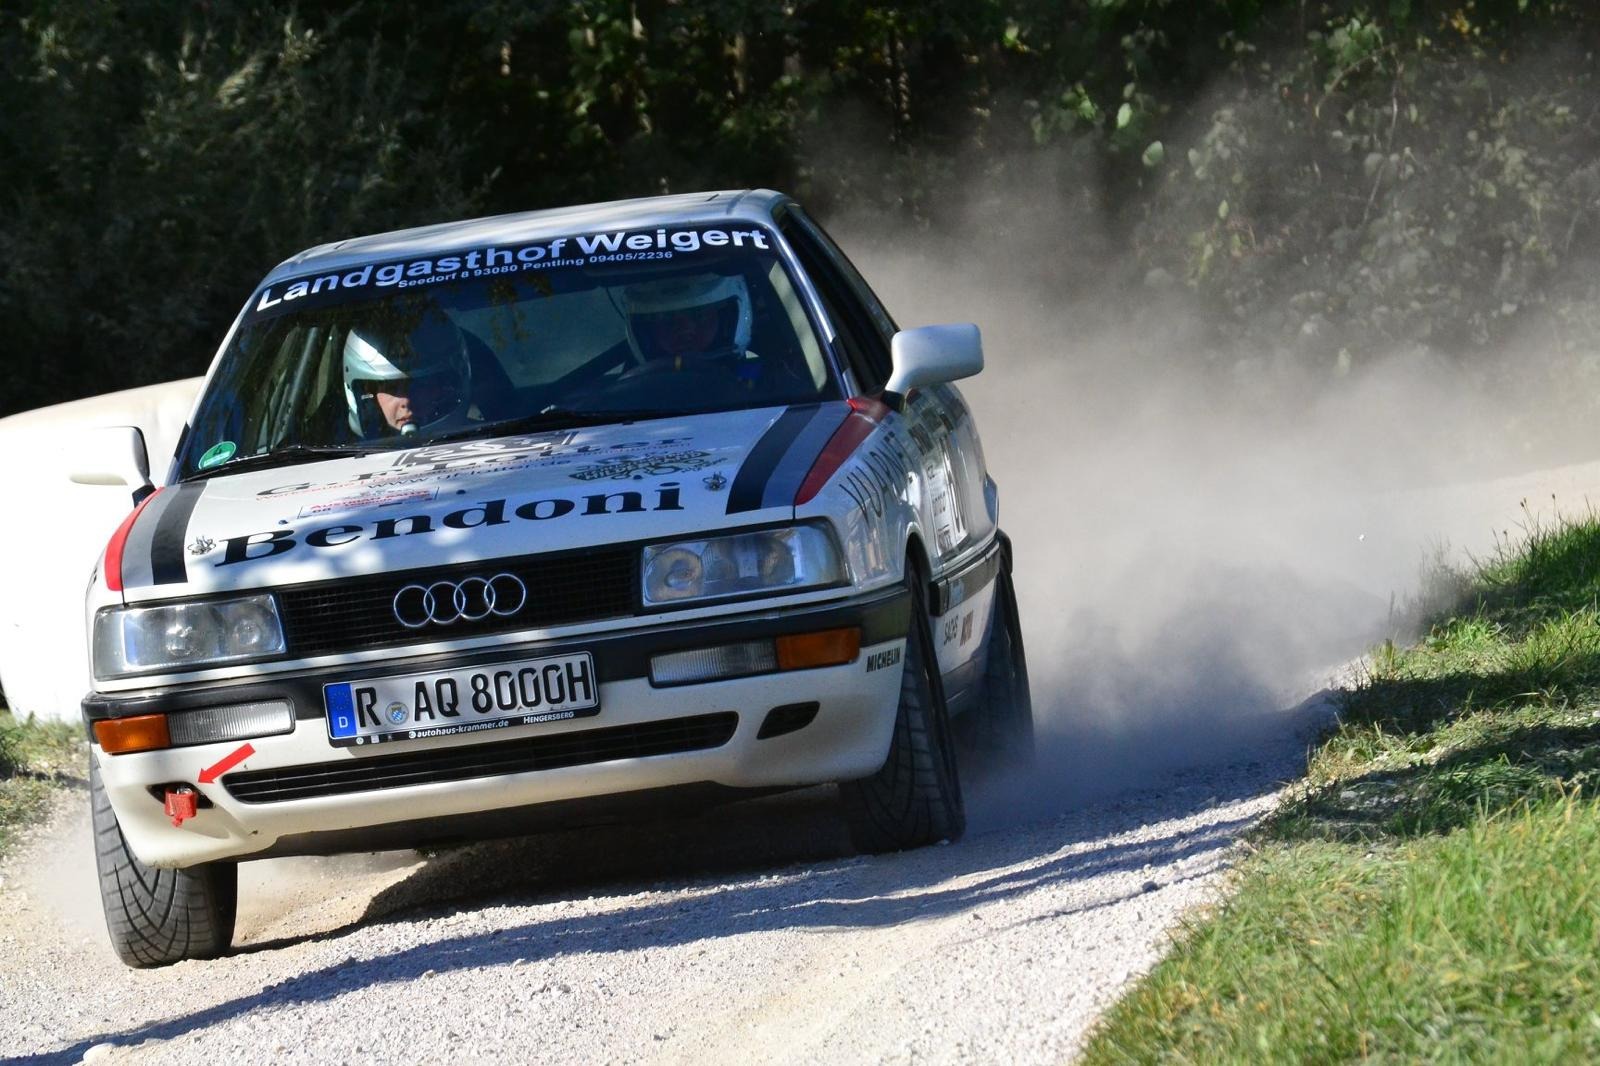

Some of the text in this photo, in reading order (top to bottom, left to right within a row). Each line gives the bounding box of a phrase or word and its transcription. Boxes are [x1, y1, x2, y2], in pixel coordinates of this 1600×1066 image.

[256, 228, 770, 312] Landgasthof Weigert
[398, 250, 673, 288] Seedorf 8 93080 Pentling 09405/2236
[214, 481, 686, 567] Bendoni
[866, 647, 901, 672] MICHELIN
[355, 660, 592, 728] R AQ 8000H
[338, 716, 349, 728] D
[417, 710, 576, 738] autohaus-krammer.de HENGERSBERG
